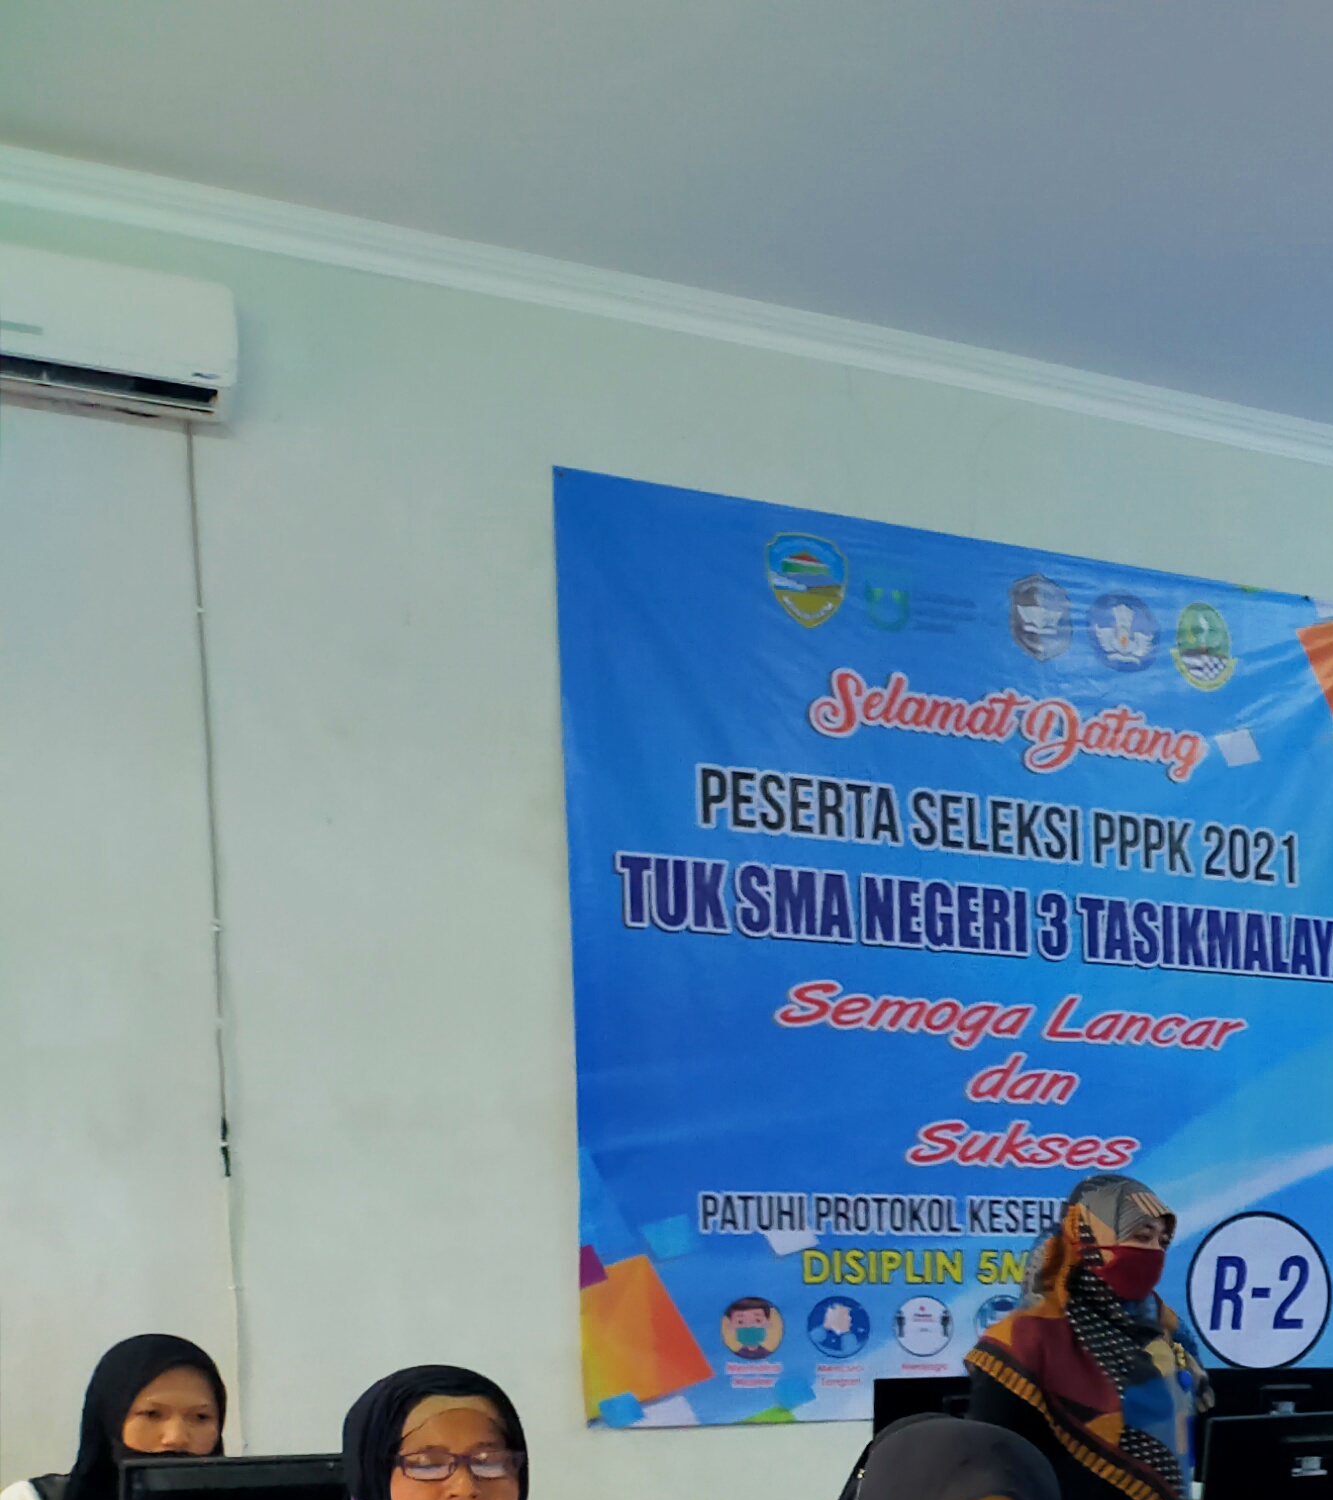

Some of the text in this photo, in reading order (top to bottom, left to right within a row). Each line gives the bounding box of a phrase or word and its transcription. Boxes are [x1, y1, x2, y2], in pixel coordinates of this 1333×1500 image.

[812, 670, 1205, 781] Selamat Datang
[699, 767, 1297, 884] PESERTA SELEKSI PPPK 2021
[618, 854, 729, 931] TUK
[738, 864, 853, 939] SMA
[864, 875, 1028, 953] NEGERI
[1040, 892, 1069, 957] 3
[777, 982, 1246, 1049] Semoga Lancar
[968, 1054, 1078, 1102] dan
[908, 1120, 1139, 1168] Sukses
[701, 1196, 1068, 1233] PATUHI PROTOKOL KESEH
[803, 1249, 963, 1285] DISIPLIN
[1209, 1254, 1310, 1331] R-2
